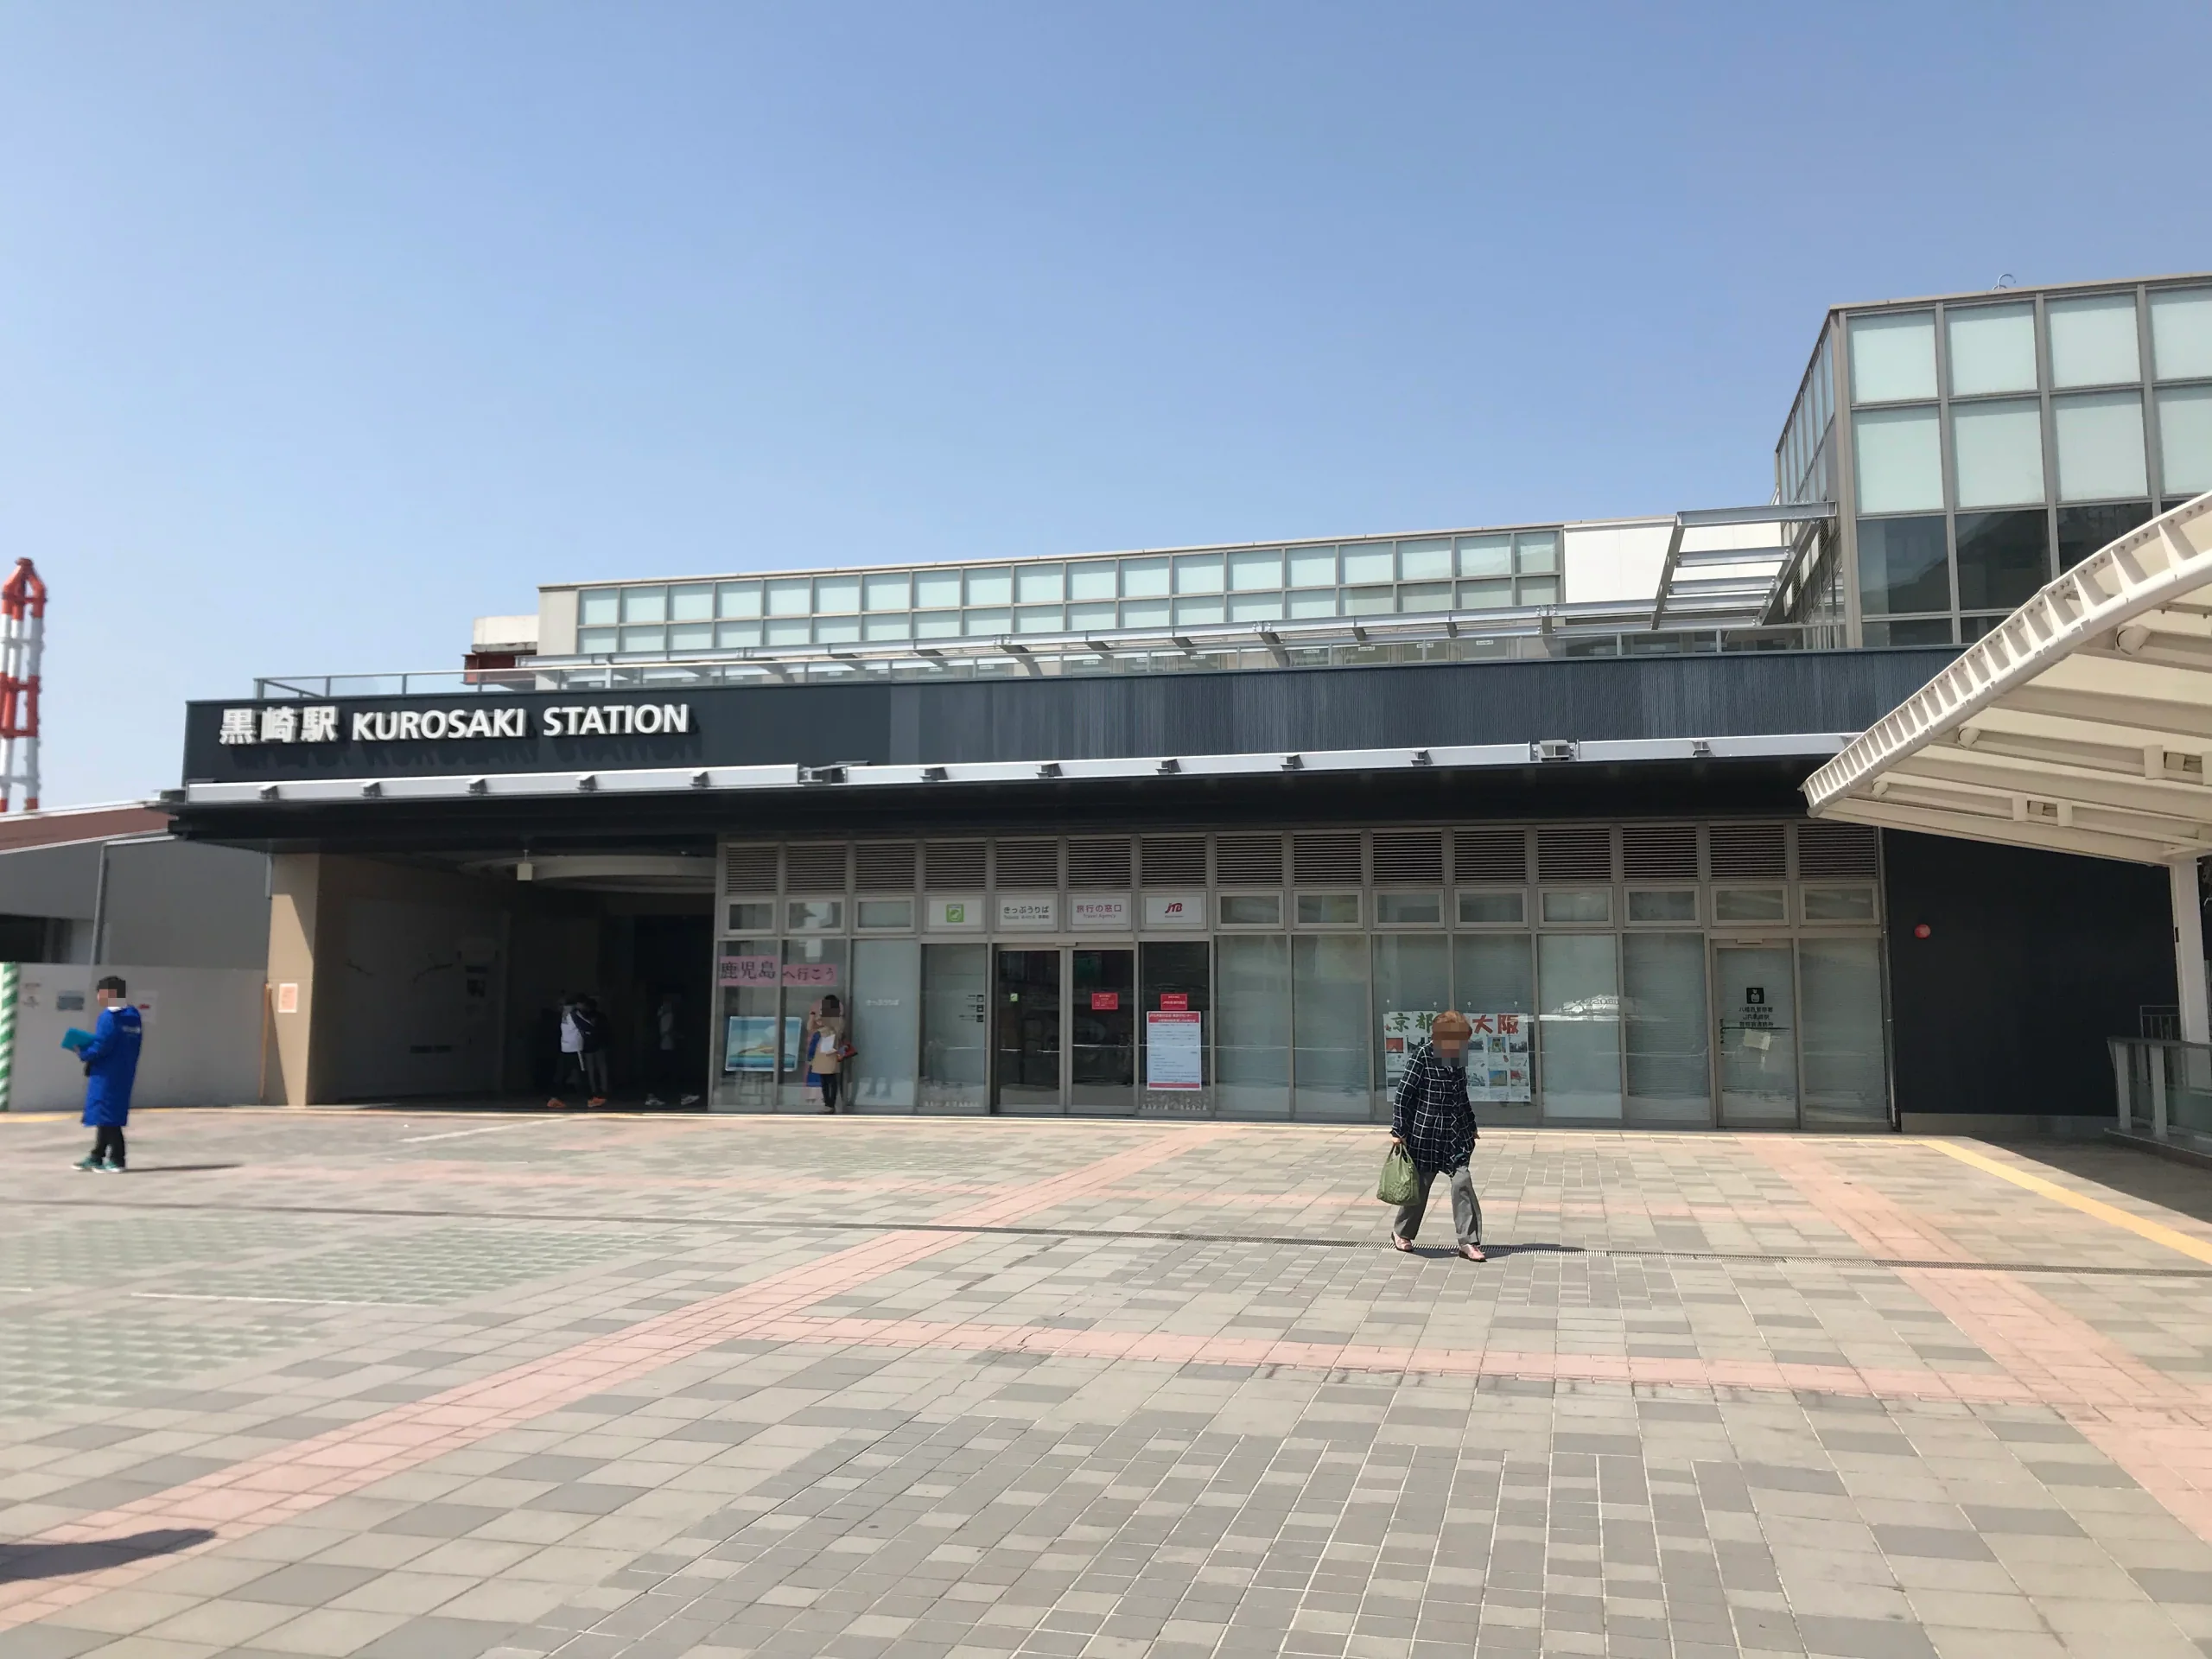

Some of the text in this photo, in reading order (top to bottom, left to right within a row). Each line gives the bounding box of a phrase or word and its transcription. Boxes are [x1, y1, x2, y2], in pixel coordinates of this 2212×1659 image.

[219, 704, 690, 745] 黒崎駅 KUROSAKI STATION
[1003, 906, 1050, 914] きっぷうりば
[1076, 904, 1122, 913] 旅行の窓口
[1165, 902, 1183, 914] JTB
[720, 960, 776, 981] 鹿児島
[1390, 1012, 1434, 1033] 京都
[1471, 1014, 1519, 1035] 大阪
